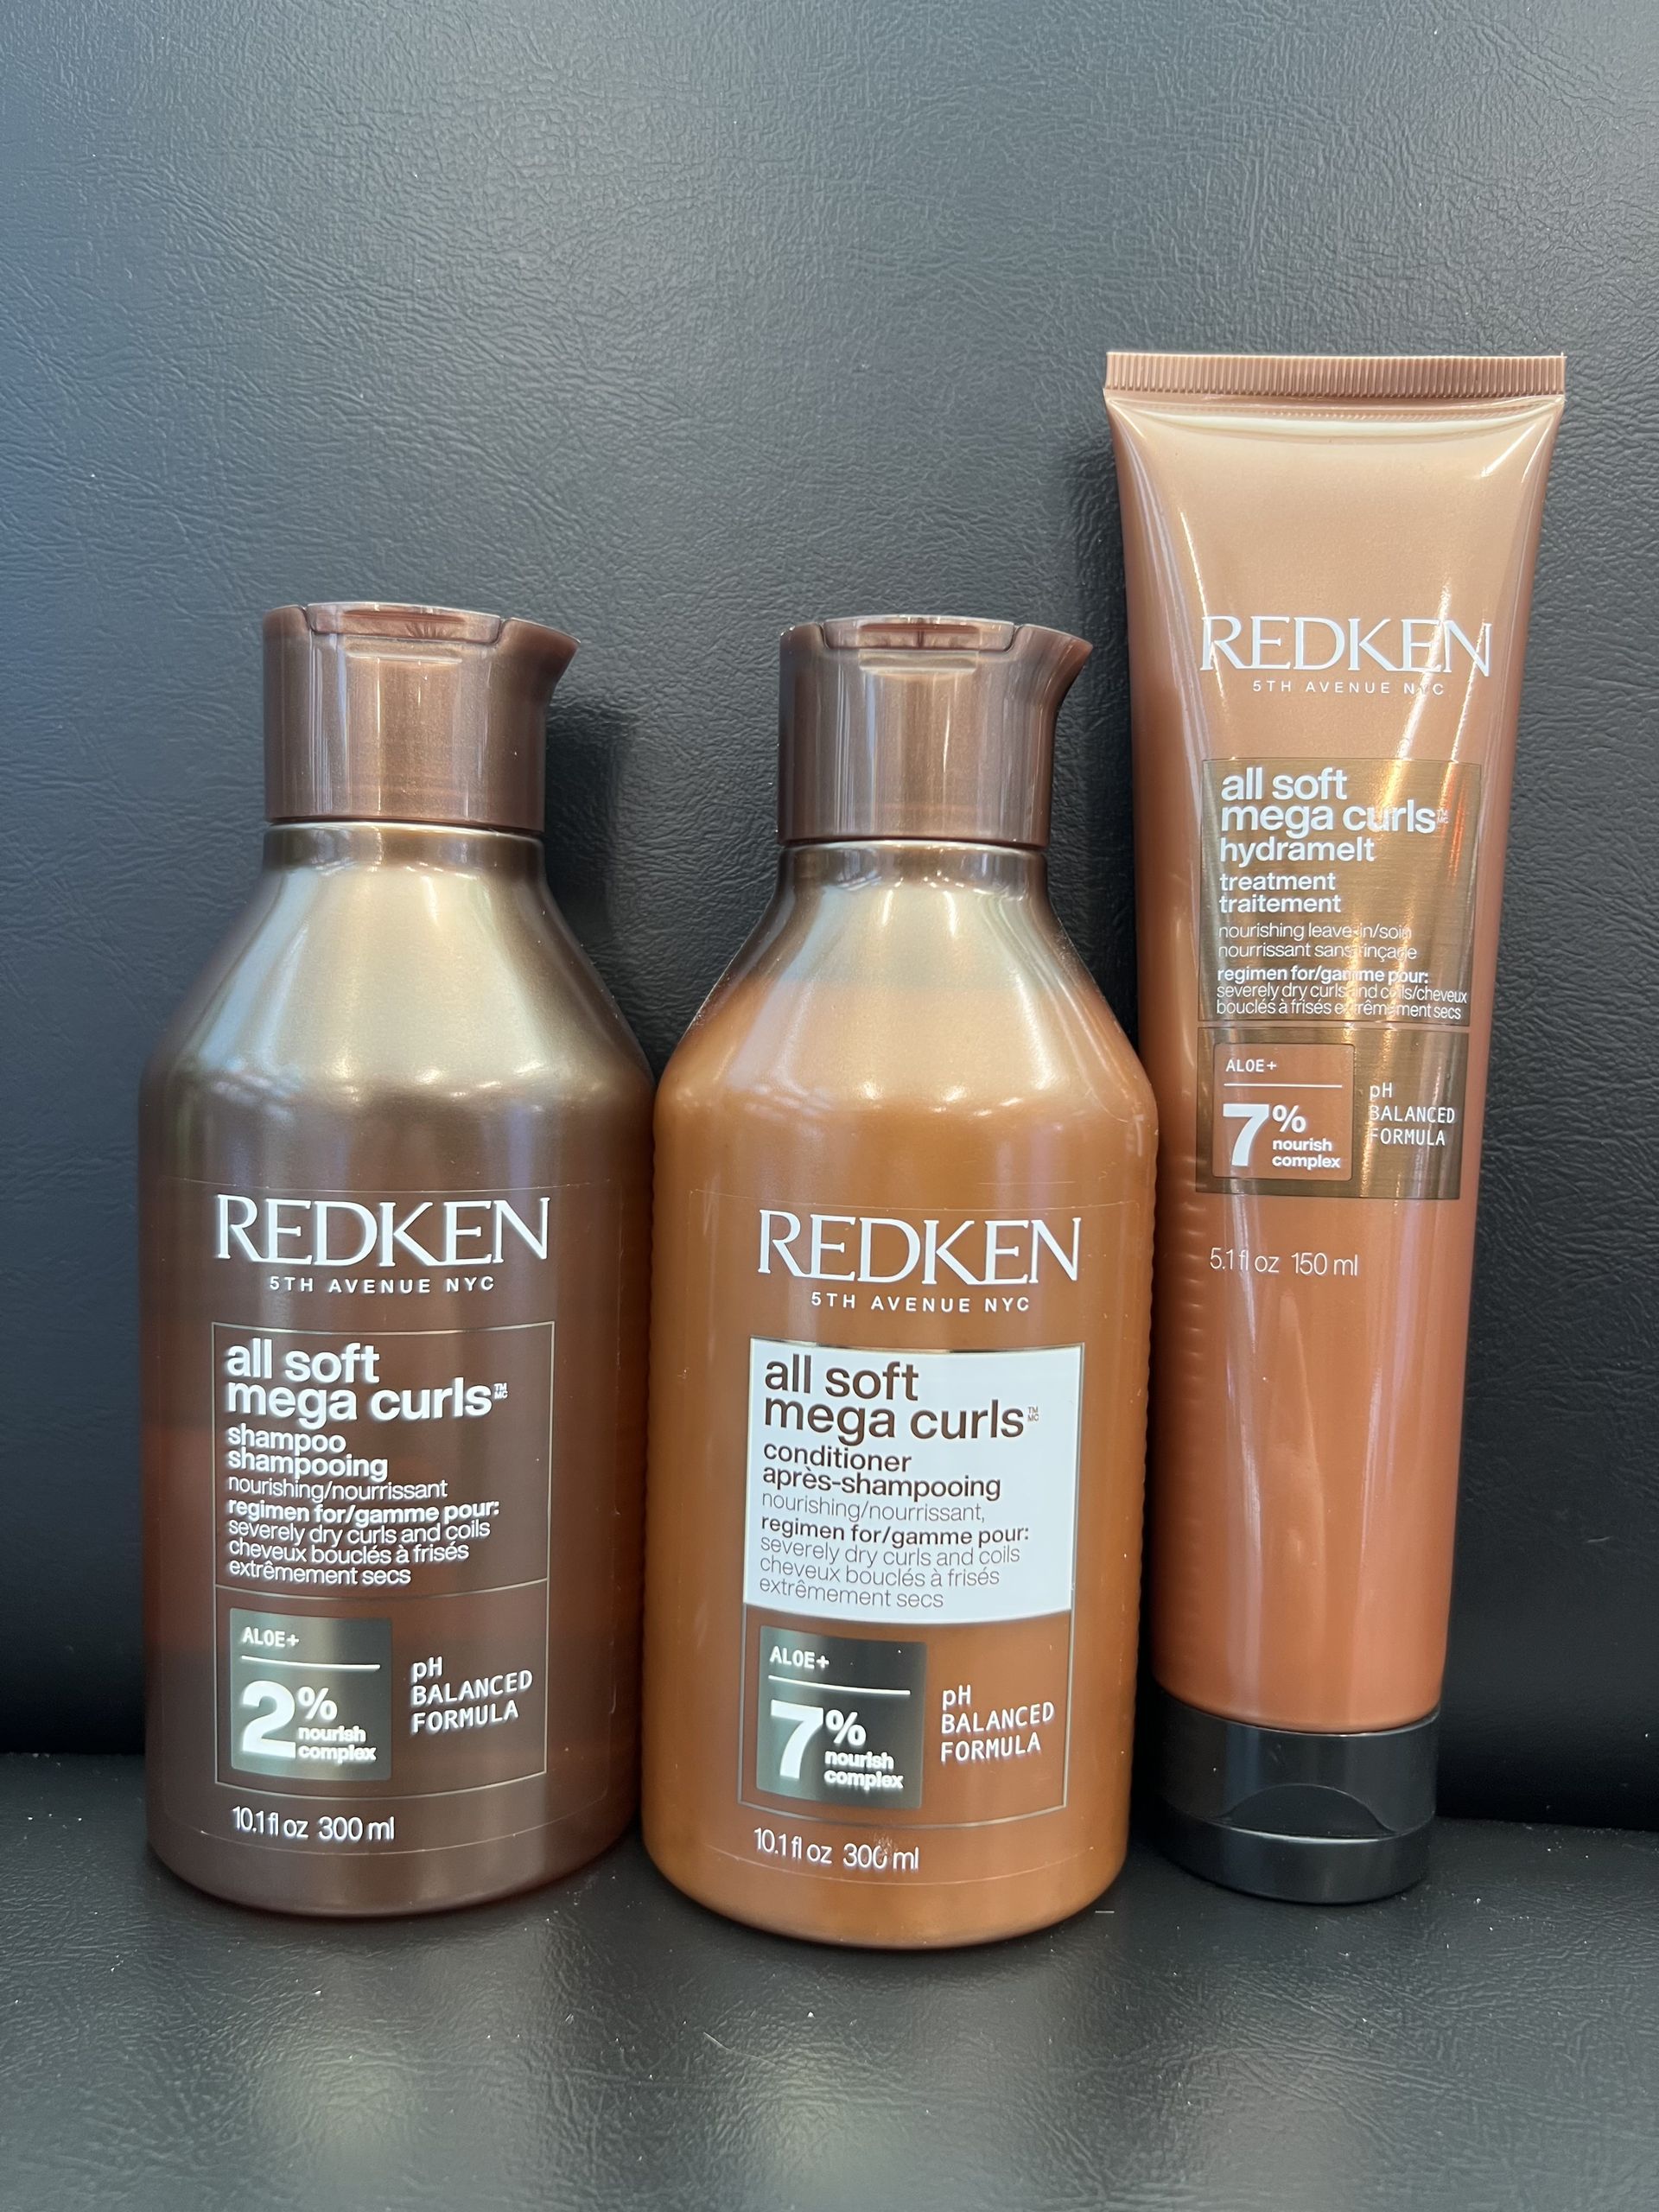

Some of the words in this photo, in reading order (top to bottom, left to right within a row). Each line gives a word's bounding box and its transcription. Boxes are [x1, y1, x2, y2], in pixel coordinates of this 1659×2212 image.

[1200, 615, 1491, 677] REDKEN
[1253, 680, 1291, 692] 5TH
[1306, 682, 1390, 693] AVENUE
[1403, 683, 1444, 696] NYC
[1221, 767, 1262, 800] all
[1272, 767, 1347, 800] soft
[1221, 805, 1341, 839] mega
[1343, 800, 1436, 833] curls
[1220, 836, 1375, 866] hydramelt
[1220, 873, 1335, 891] treatment
[1219, 894, 1341, 912] traitement
[1218, 923, 1304, 941] nourishing
[1218, 943, 1311, 958] nourrissant
[1314, 944, 1351, 957] sans
[1217, 966, 1287, 984] regimen
[1291, 966, 1384, 984] for/gamme
[1389, 970, 1428, 984] pour:
[1217, 982, 1279, 1000] severely
[1282, 983, 1306, 1000] dry
[1310, 984, 1344, 998] curls
[1217, 999, 1275, 1014] bouclés
[1279, 1001, 1287, 1014] à
[1291, 1001, 1331, 1014] frisés
[1334, 1001, 1431, 1018] erêmment
[1433, 1006, 1461, 1020] secs
[1225, 1059, 1277, 1072] ALOE+
[1370, 1083, 1392, 1100] pH
[1370, 1105, 1455, 1123] BALANCED
[1273, 1138, 1332, 1152] nourish
[1370, 1128, 1445, 1146] FORMULA
[1272, 1154, 1340, 1170] complex
[216, 1194, 550, 1267] REDKEN
[758, 1209, 1081, 1285] REDKEN
[1210, 1248, 1234, 1270] 5.1
[1255, 1255, 1280, 1274] oz
[1292, 1253, 1327, 1275] 150
[1334, 1254, 1358, 1275] ml
[270, 1277, 314, 1292] 5TH
[329, 1279, 430, 1294] AVENUE
[446, 1276, 494, 1292] NYC
[811, 1292, 855, 1308] 5TH
[871, 1295, 969, 1313] AVENUE
[985, 1297, 1029, 1313] NYC
[226, 1338, 272, 1379] all
[285, 1343, 379, 1383] soft
[765, 1354, 810, 1394] all
[825, 1362, 918, 1401] soft
[228, 1382, 357, 1430] mega
[372, 1377, 492, 1421] curls
[765, 1397, 895, 1446] mega
[911, 1399, 1024, 1439] curls
[228, 1424, 346, 1453] shampoo
[228, 1447, 388, 1482] shampooing
[764, 1442, 912, 1472] conditioner
[229, 1476, 448, 1503] nourishing/nourrissant
[763, 1466, 1001, 1502] après-shampooing
[229, 1498, 309, 1522] regimen
[315, 1504, 439, 1528] for/gamme
[444, 1500, 499, 1525] pour:
[762, 1491, 985, 1522] nourishing/nourrissant,
[229, 1520, 305, 1547] severely
[310, 1526, 343, 1548] dry
[346, 1526, 397, 1544] curls
[401, 1523, 441, 1542] and
[446, 1520, 491, 1540] coils
[762, 1516, 844, 1541] regimen
[851, 1524, 972, 1548] for/gamme
[979, 1526, 1028, 1548] pour:
[229, 1539, 307, 1561] cheveux
[311, 1545, 391, 1564] bouclés
[397, 1545, 410, 1564] à
[414, 1541, 469, 1562] frisés
[760, 1537, 839, 1564] severely
[845, 1546, 877, 1566] dry
[884, 1548, 931, 1566] curls
[937, 1547, 974, 1565] and
[980, 1546, 1020, 1564] coils
[229, 1560, 358, 1586] extrêmement
[362, 1567, 411, 1585] secs
[760, 1557, 840, 1581] cheveux
[846, 1567, 925, 1587] bouclés
[931, 1568, 942, 1586] à
[948, 1567, 1000, 1586] frisés
[760, 1580, 891, 1607] extrêmement
[897, 1592, 944, 1608] secs
[411, 1656, 442, 1684] pH
[411, 1669, 532, 1707] BALANCED
[942, 1685, 971, 1710] pH
[411, 1700, 518, 1734] FORMULA
[941, 1701, 1054, 1734] BALANCED
[299, 1726, 365, 1743] nourish
[941, 1732, 1040, 1763] FORMULA
[298, 1745, 377, 1764] complex
[825, 1750, 893, 1770] nourish
[824, 1770, 904, 1791] complex
[232, 1806, 264, 1834] 10.1
[284, 1819, 308, 1839] oz
[319, 1816, 364, 1842] 300
[368, 1816, 395, 1840] ml
[753, 1827, 786, 1856] 10.1
[806, 1844, 832, 1864] oz
[843, 1843, 887, 1869] 300
[893, 1847, 918, 1870] ml
